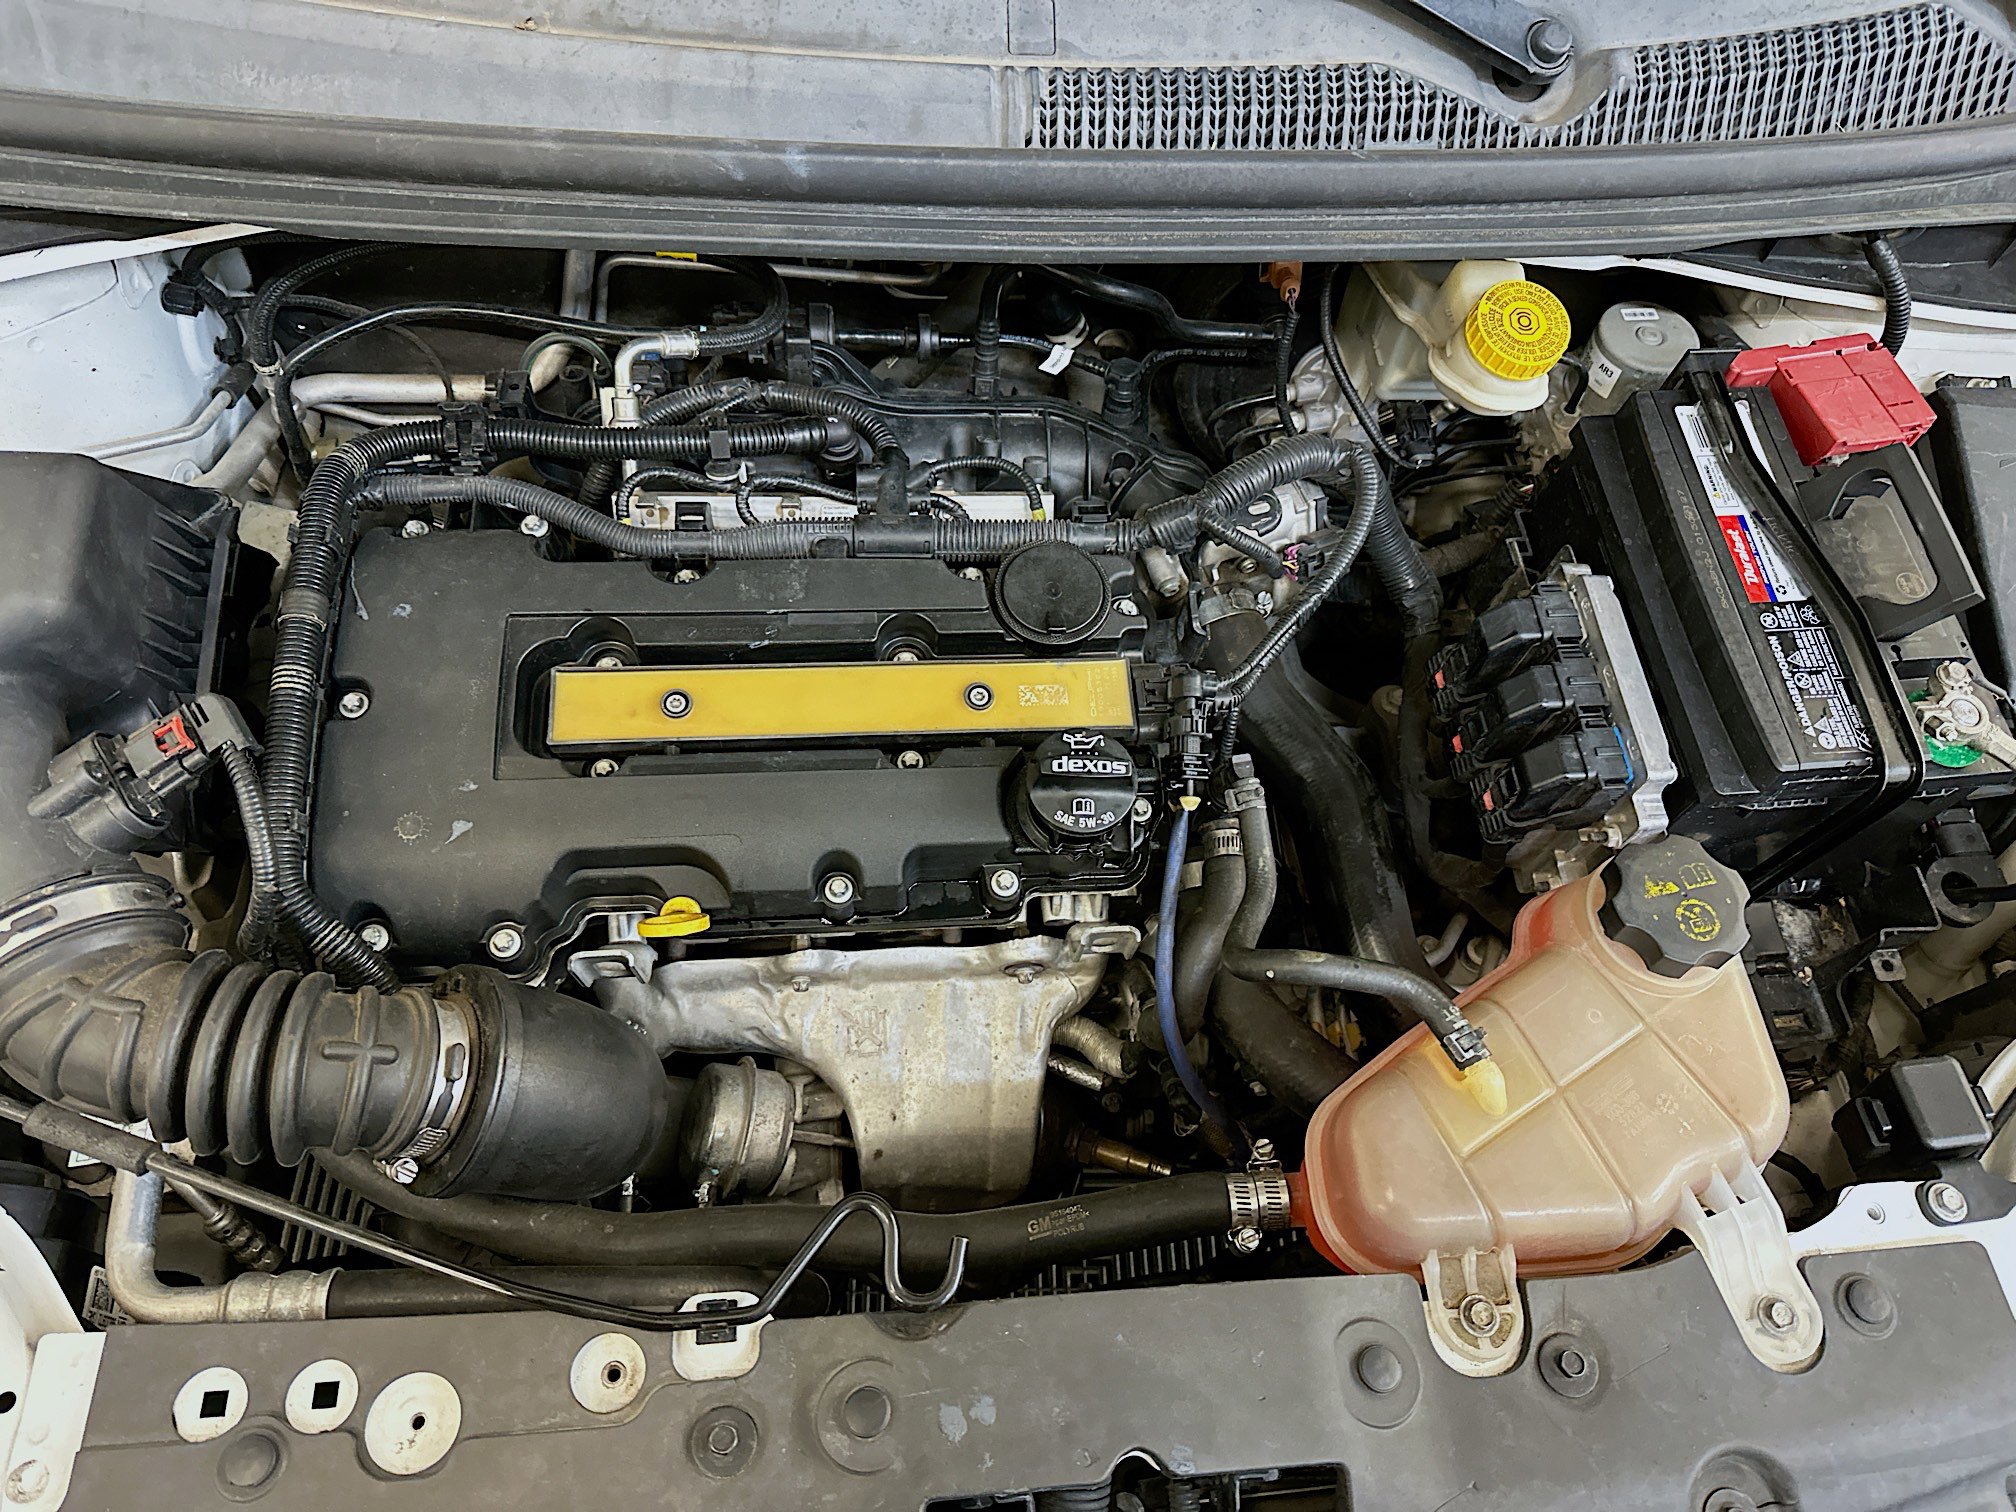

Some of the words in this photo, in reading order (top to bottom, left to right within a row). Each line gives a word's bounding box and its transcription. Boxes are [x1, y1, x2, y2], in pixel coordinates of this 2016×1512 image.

[1533, 285, 1546, 296] CAP
[1598, 363, 1614, 378] AR3
[1727, 529, 1759, 585] Duralast
[1768, 635, 1812, 727] DANGER/POISON
[1052, 756, 1130, 774] dexos
[1054, 810, 1075, 827] SAE
[1078, 811, 1116, 828] 5W-30
[1026, 1215, 1051, 1234] GM
